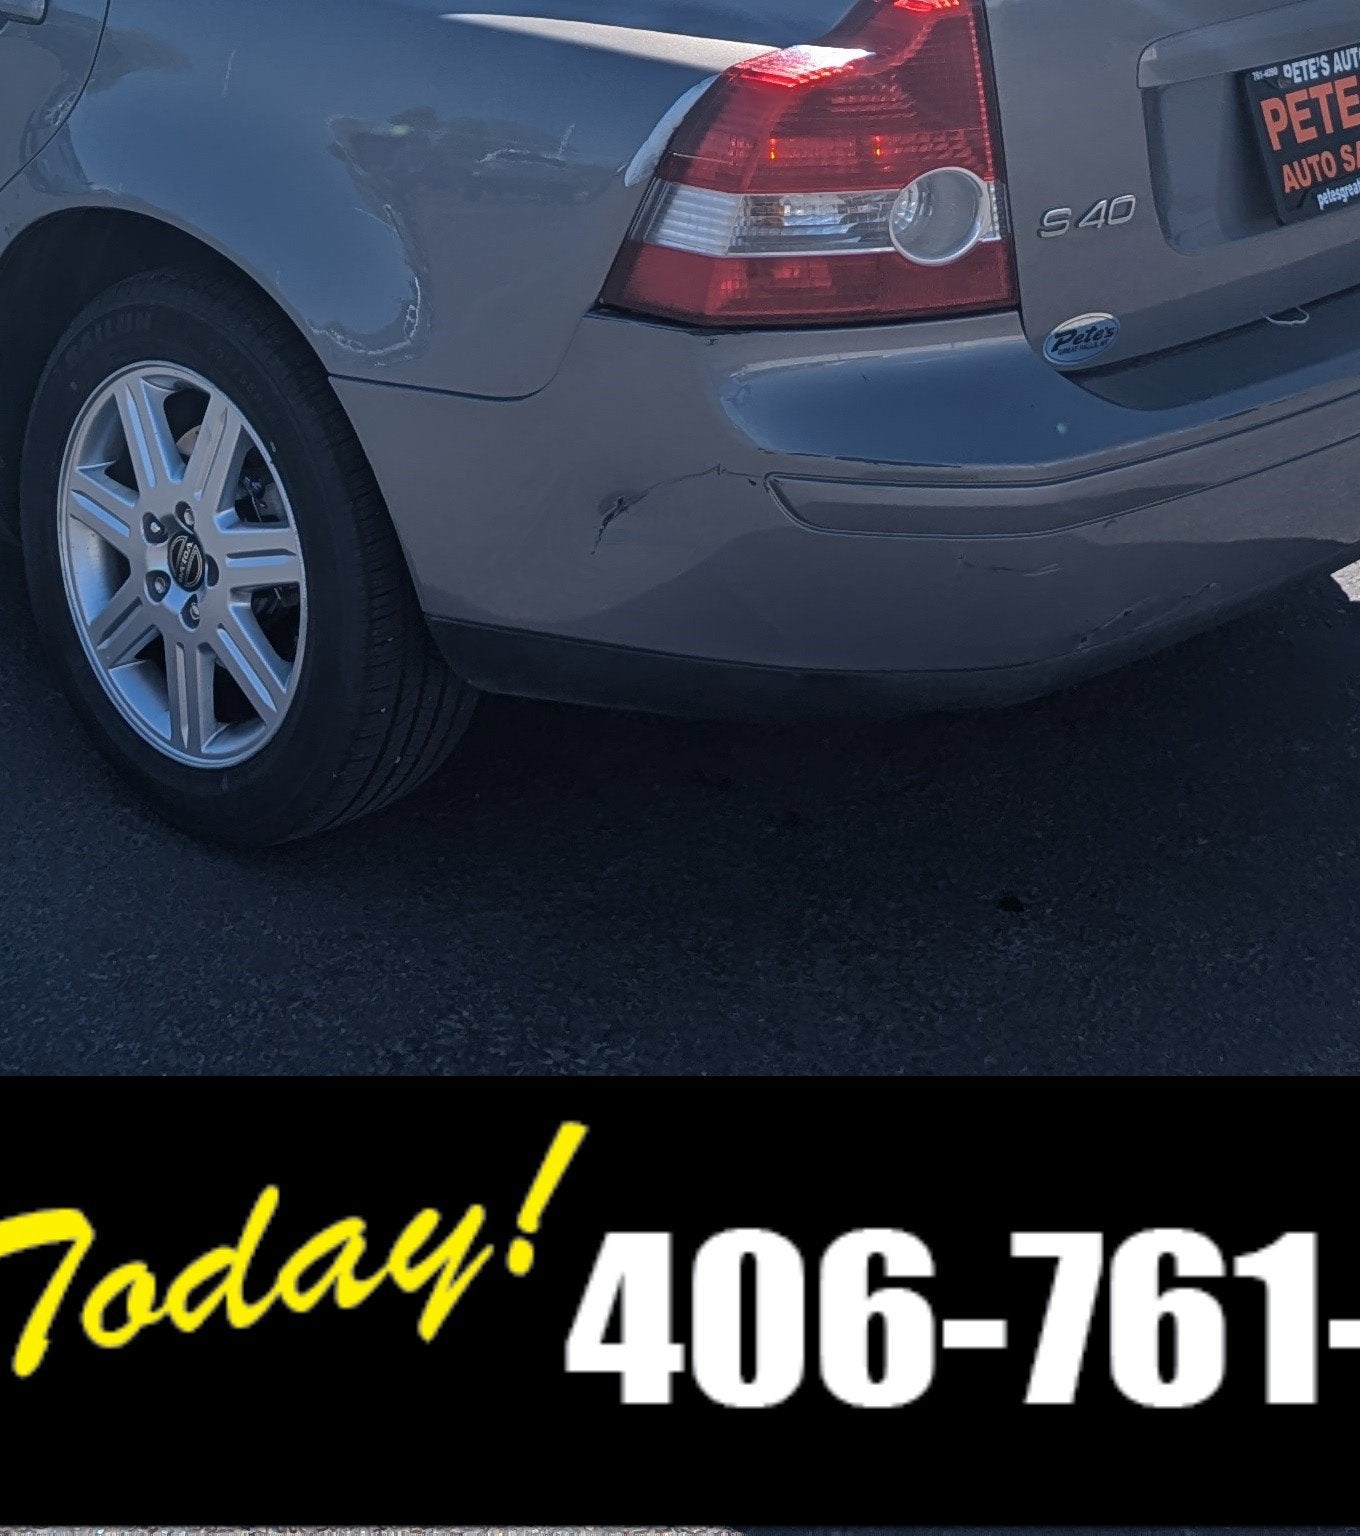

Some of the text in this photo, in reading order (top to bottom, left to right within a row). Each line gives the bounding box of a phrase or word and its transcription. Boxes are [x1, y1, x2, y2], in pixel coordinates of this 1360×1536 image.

[1283, 54, 1330, 84] PETE'S
[1281, 150, 1337, 194] AUTO
[1051, 326, 1116, 352] Pete's
